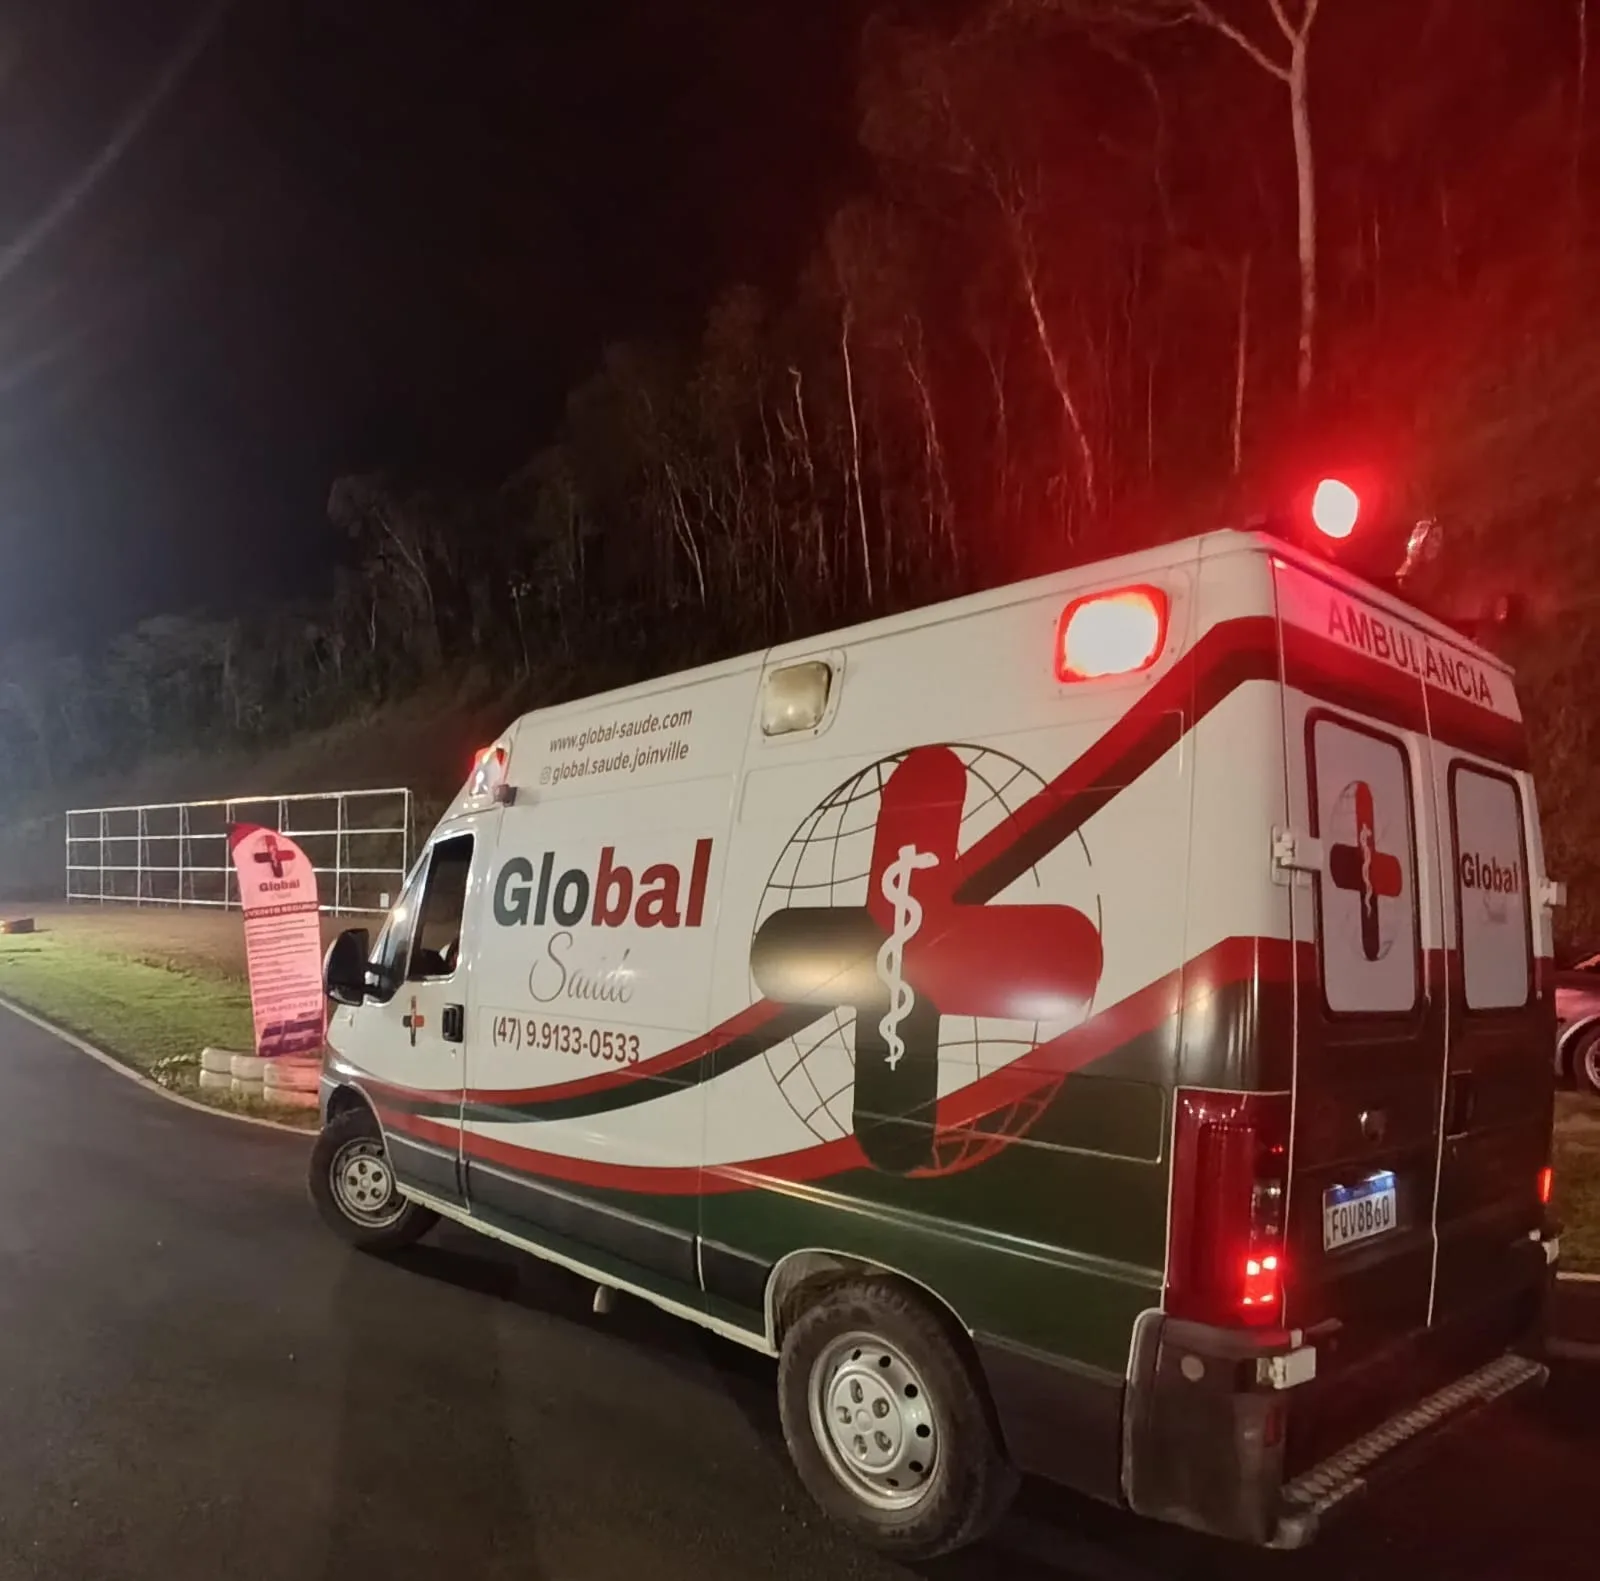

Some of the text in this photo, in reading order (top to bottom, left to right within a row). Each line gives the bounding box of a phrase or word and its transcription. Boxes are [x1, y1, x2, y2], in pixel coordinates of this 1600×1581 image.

[549, 709, 693, 752] www.global-saude.com
[259, 879, 300, 892] Global
[493, 838, 713, 928] Global
[1461, 852, 1518, 894] Global
[492, 1015, 640, 1064] (47) 9.9133-0533
[1332, 1195, 1389, 1241] FQV8B60
